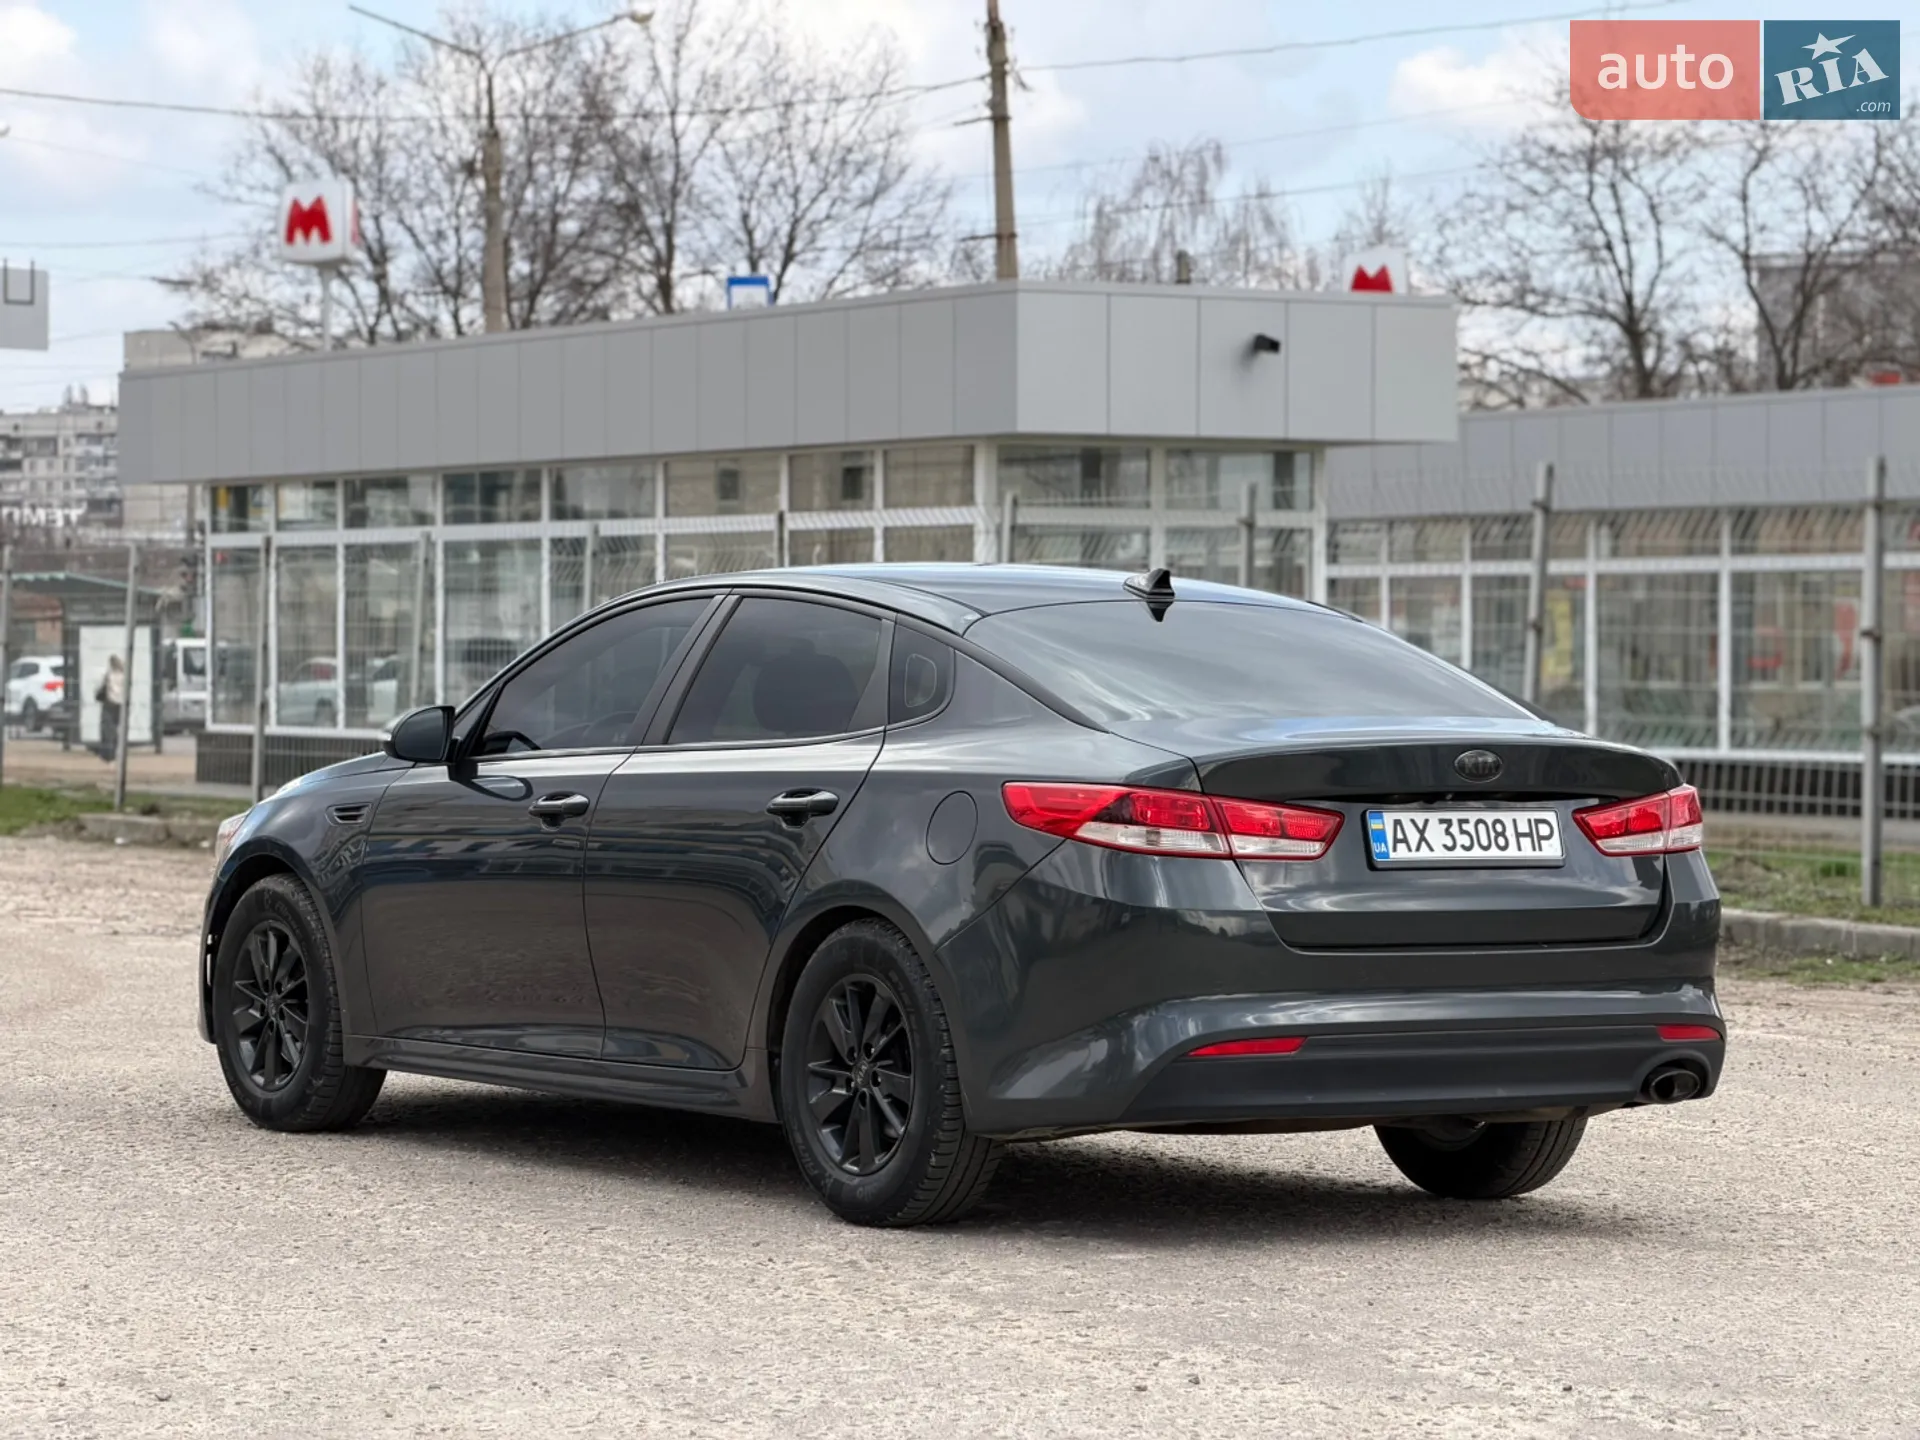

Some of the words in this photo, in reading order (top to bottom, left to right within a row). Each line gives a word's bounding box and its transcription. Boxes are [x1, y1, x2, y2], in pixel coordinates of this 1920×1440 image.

[1463, 756, 1498, 775] KIA
[1391, 818, 1435, 853] AX
[1437, 817, 1510, 852] 3508
[1511, 817, 1556, 852] HP
[1373, 842, 1388, 853] UA
